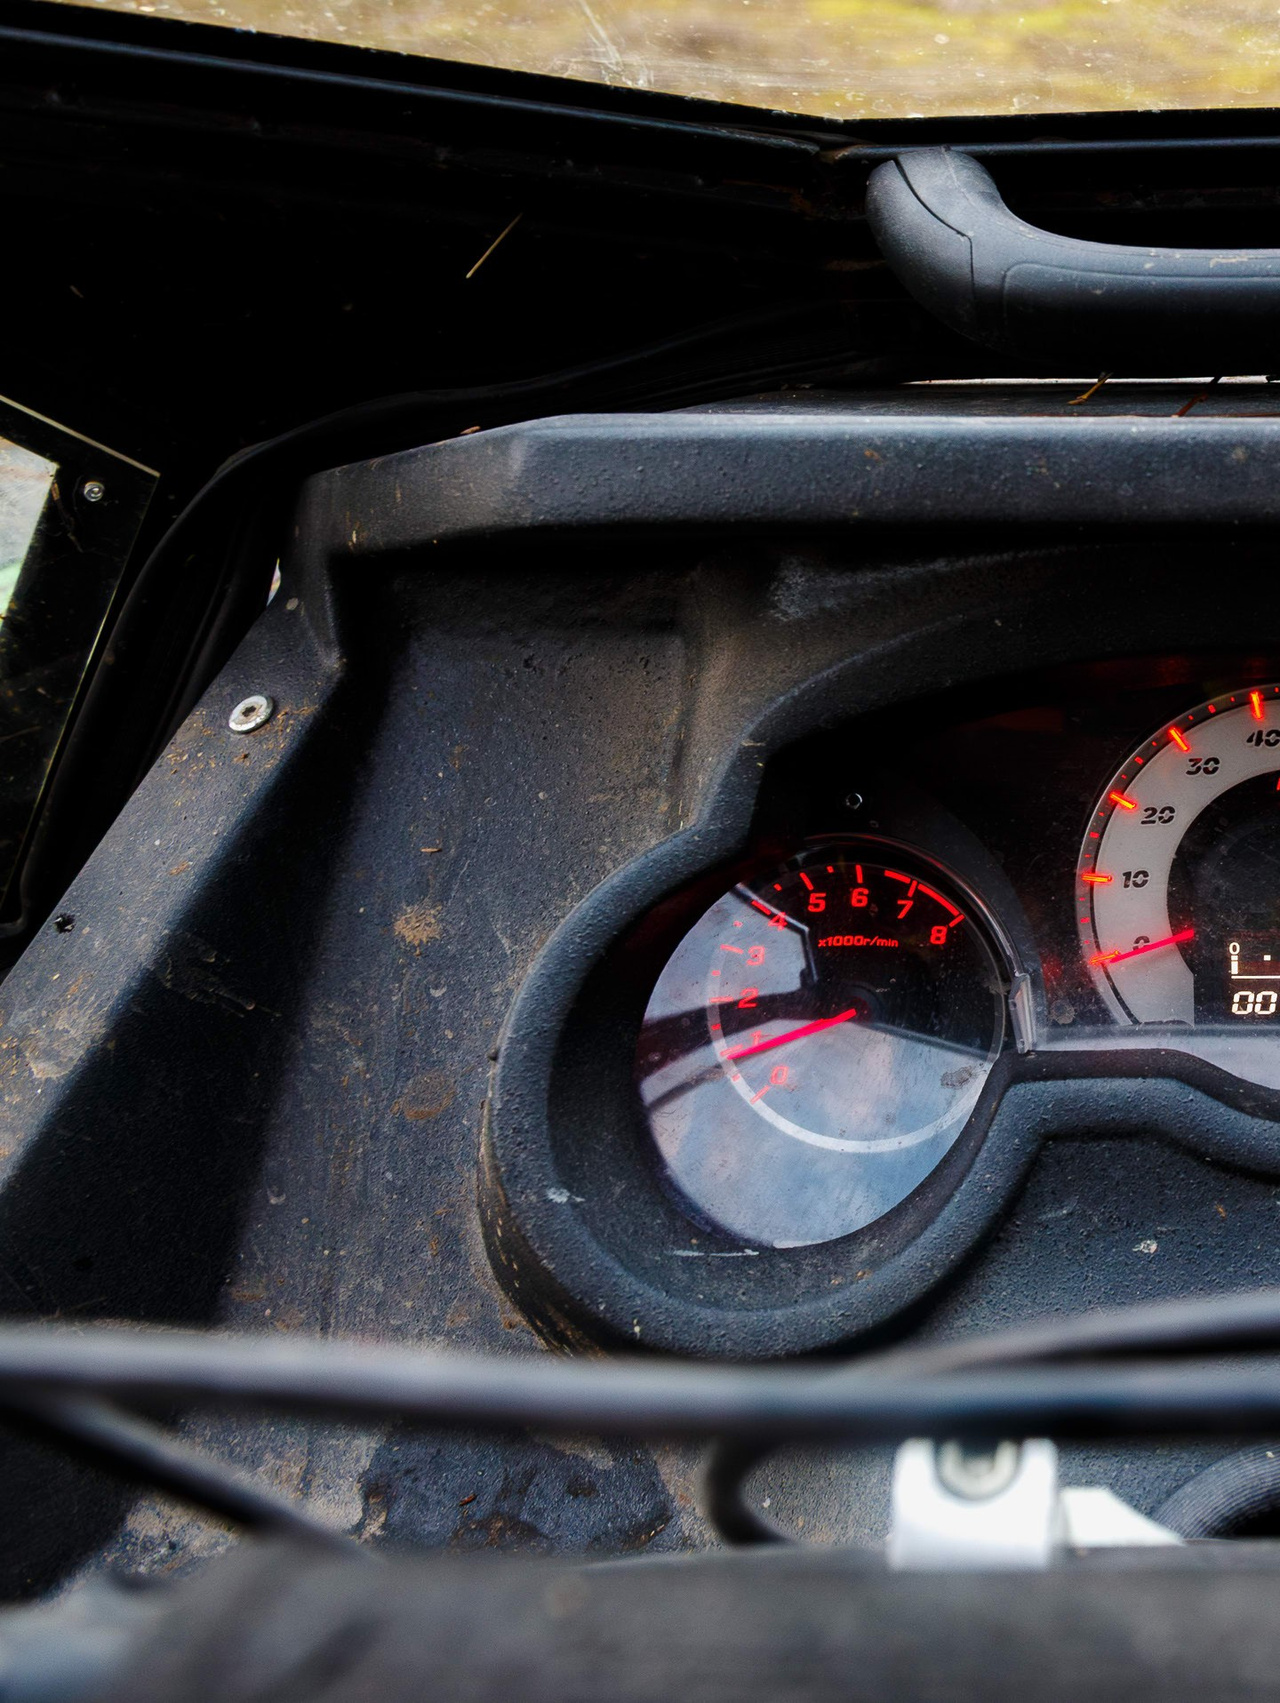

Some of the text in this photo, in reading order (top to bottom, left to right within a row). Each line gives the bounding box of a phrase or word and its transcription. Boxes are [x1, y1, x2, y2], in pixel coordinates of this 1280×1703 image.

[1185, 757, 1221, 775] 30
[1140, 805, 1176, 825] 20
[1122, 870, 1150, 889] 10
[808, 892, 827, 913] 5
[851, 887, 869, 907] 6
[896, 900, 914, 919] 7
[768, 911, 788, 931] 4
[818, 935, 899, 948] x1000r/min
[930, 925, 947, 945] 8
[746, 946, 766, 966] 3
[1229, 942, 1240, 955] 0
[738, 987, 759, 1008] 2
[769, 1065, 789, 1085] 0
